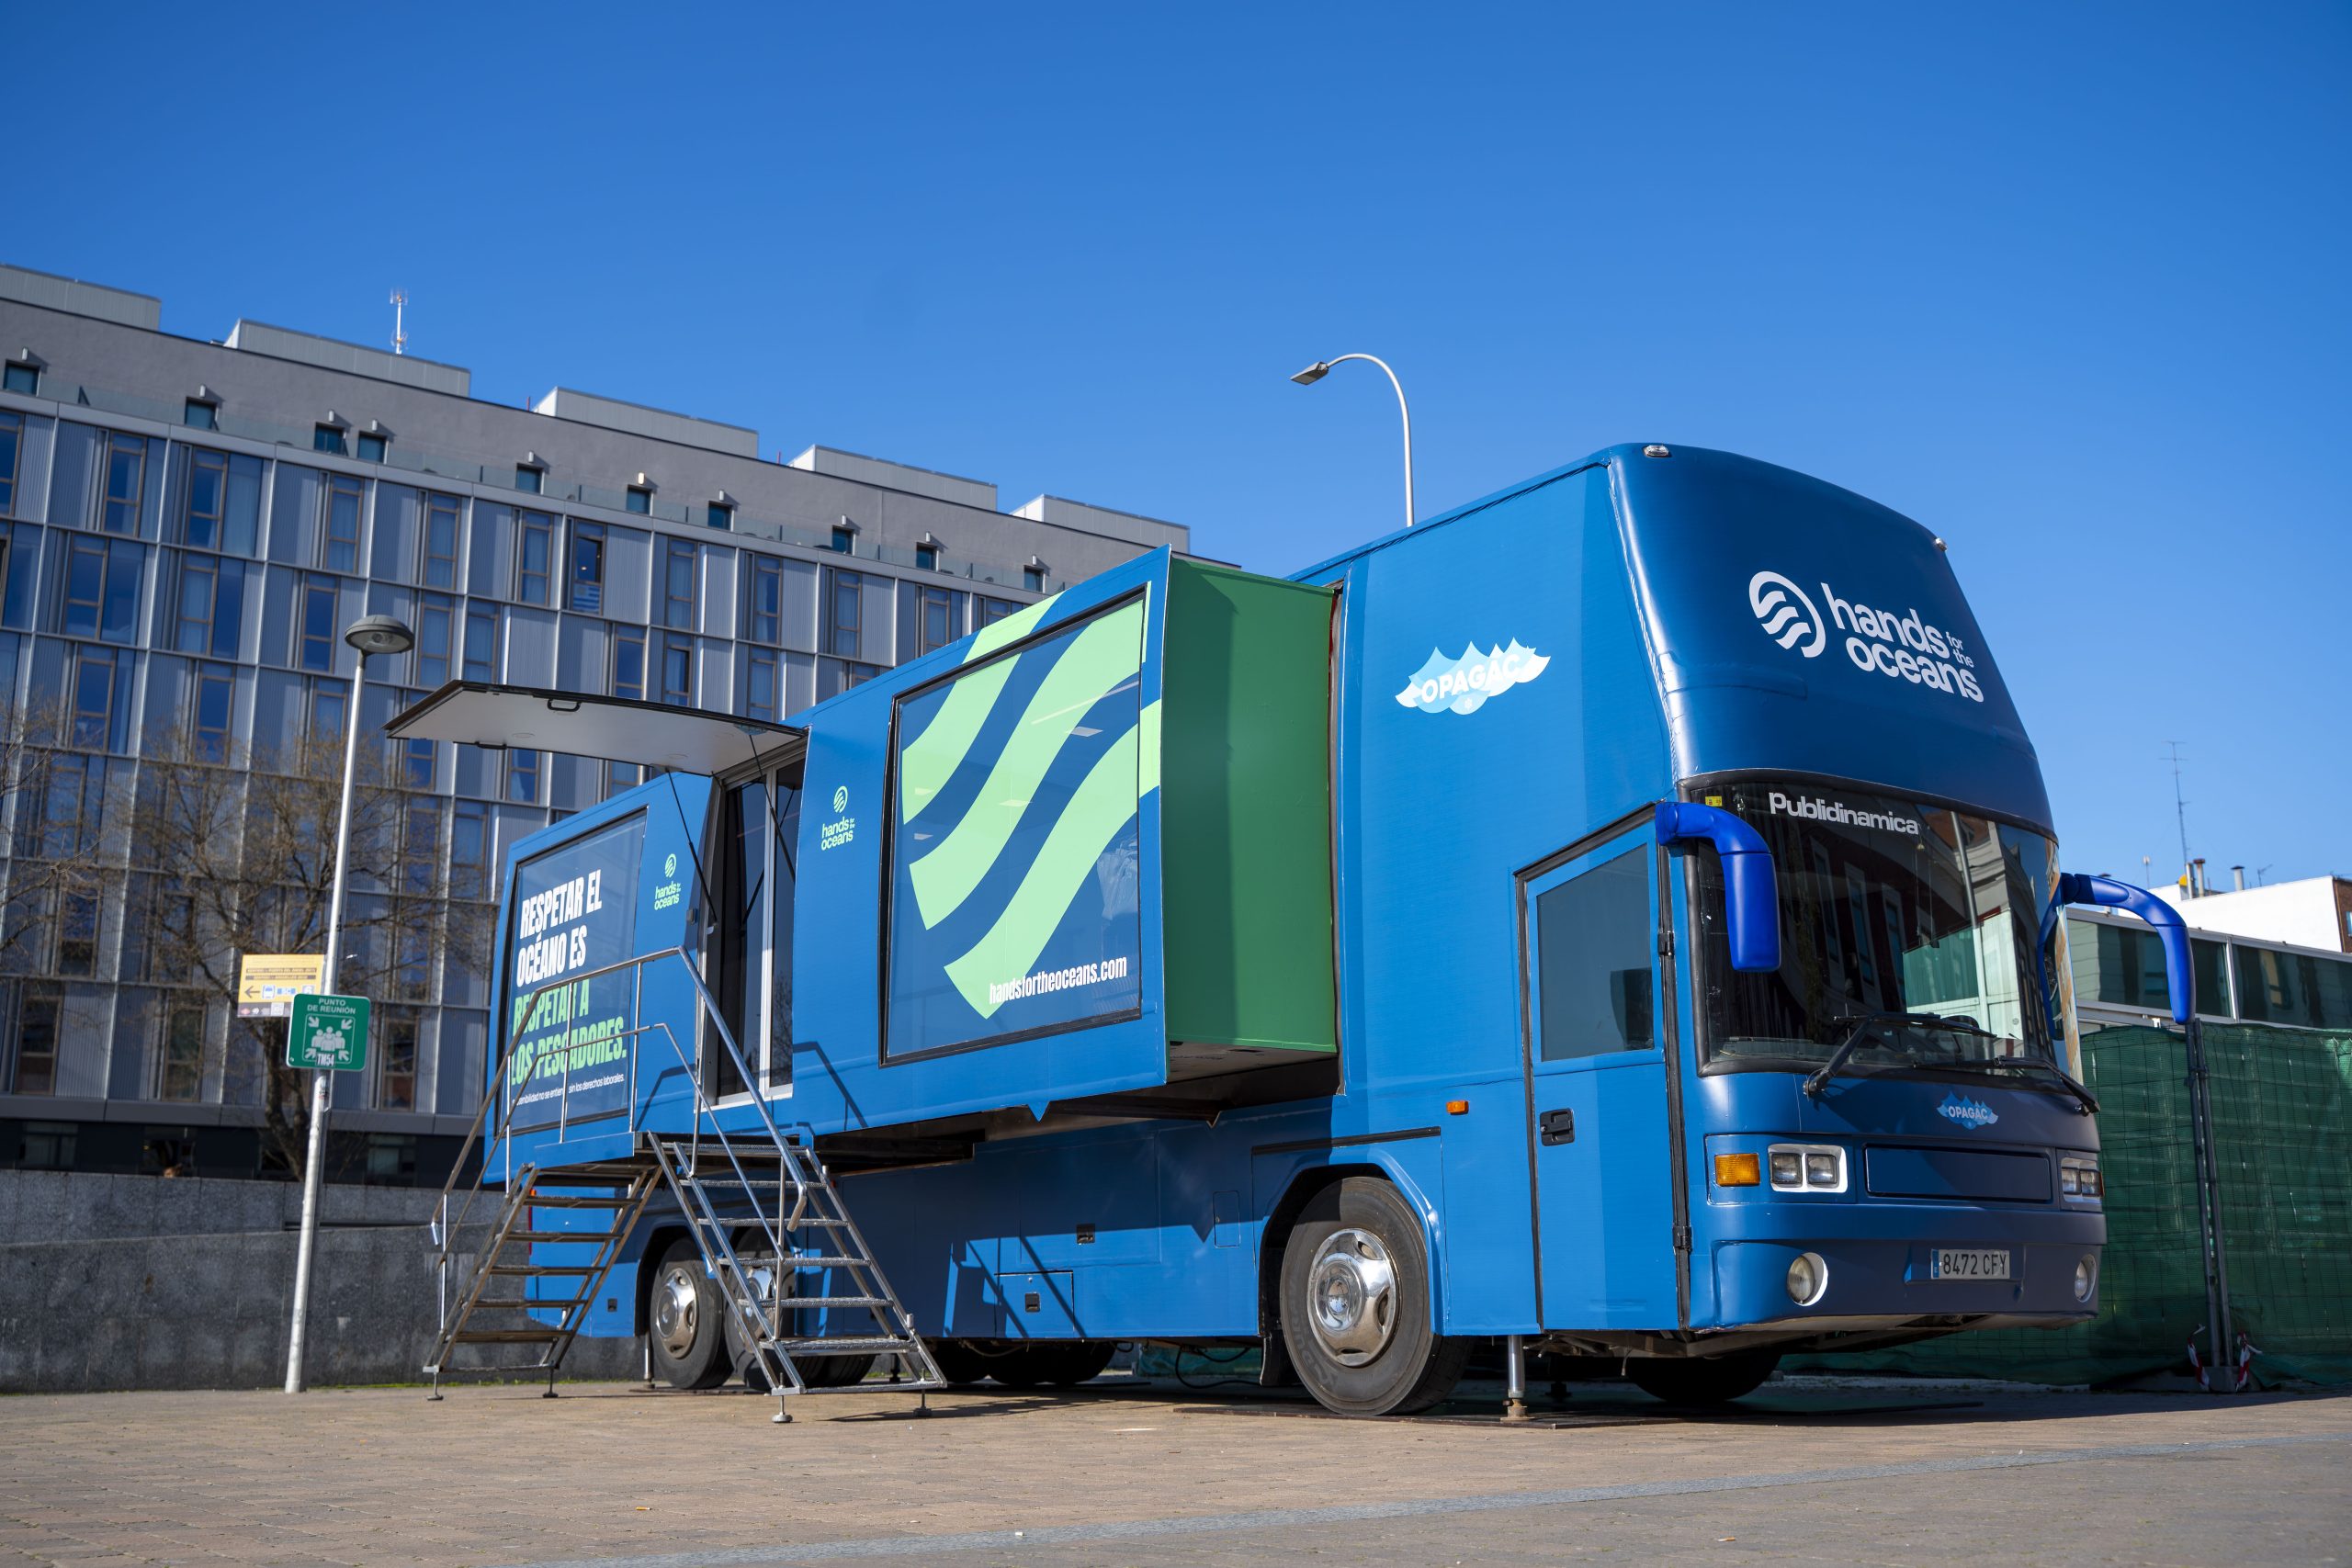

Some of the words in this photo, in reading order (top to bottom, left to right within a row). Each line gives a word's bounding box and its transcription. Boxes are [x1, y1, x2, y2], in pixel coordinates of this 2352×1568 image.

[1820, 582, 1950, 659] hands
[1946, 631, 1963, 650] for
[1846, 637, 1984, 703] oceans
[1952, 649, 1974, 668] the
[1420, 653, 1522, 704] OPAGAC
[1769, 792, 1919, 835] Publidinamica
[821, 816, 849, 838] hands
[820, 829, 854, 851] oceans
[654, 893, 679, 910] oceans
[655, 881, 677, 899] hands
[520, 876, 585, 940] RESPETAR
[586, 869, 602, 914] EL
[516, 931, 567, 987] OCÉANO
[569, 924, 587, 970] ES
[989, 956, 1127, 1004] handsfortheoceans.com
[307, 1004, 319, 1012] DE
[320, 1005, 356, 1015] REUNIÓN
[319, 998, 346, 1007] PUNTO
[579, 979, 590, 1017] A
[511, 1042, 533, 1086] LOS
[536, 1016, 628, 1080] PESCADORES.
[1948, 1106, 1987, 1119] OPAGAC
[1943, 1253, 1978, 1275] 8472
[1983, 1254, 2007, 1276] CFY
